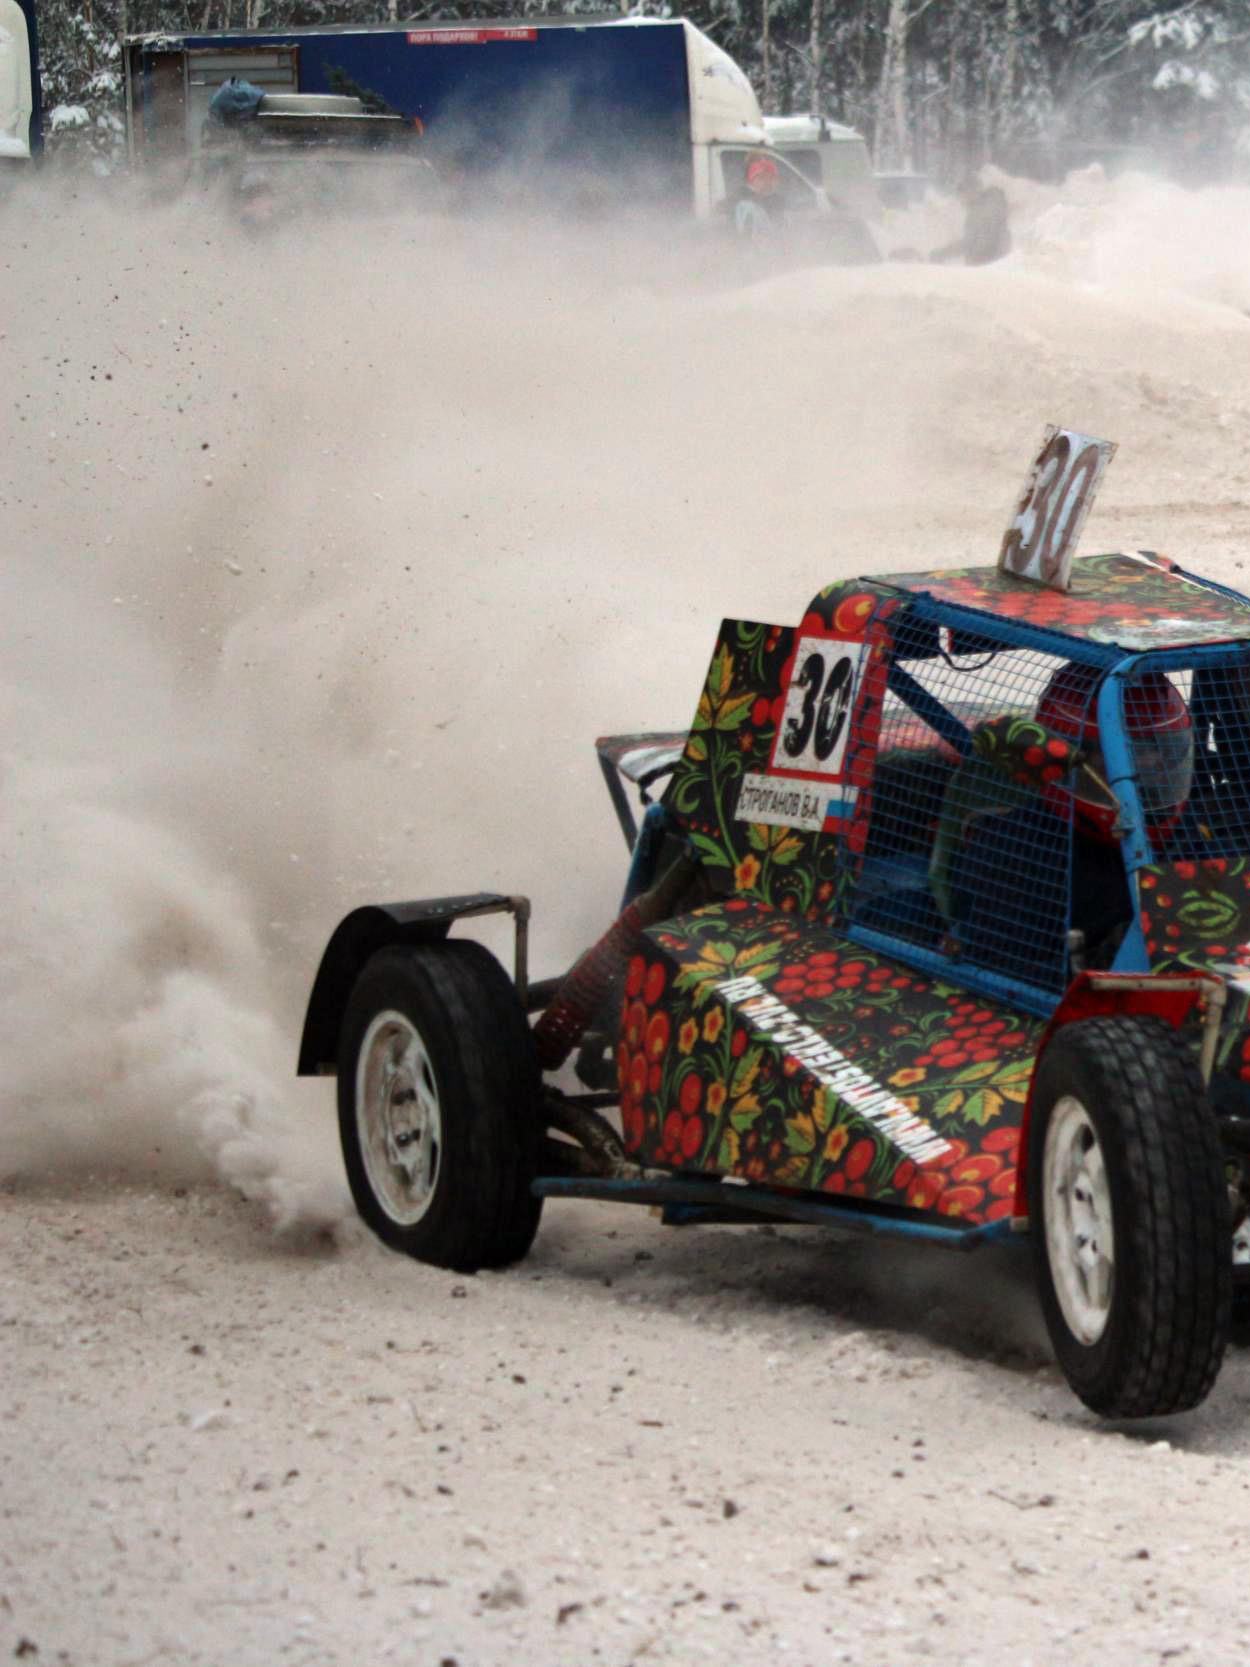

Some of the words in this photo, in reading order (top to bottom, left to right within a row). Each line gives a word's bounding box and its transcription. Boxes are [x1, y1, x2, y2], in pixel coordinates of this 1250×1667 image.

[1003, 435, 1099, 582] 30
[783, 653, 853, 762] 30
[740, 787, 800, 816] СТРОГАНОВ
